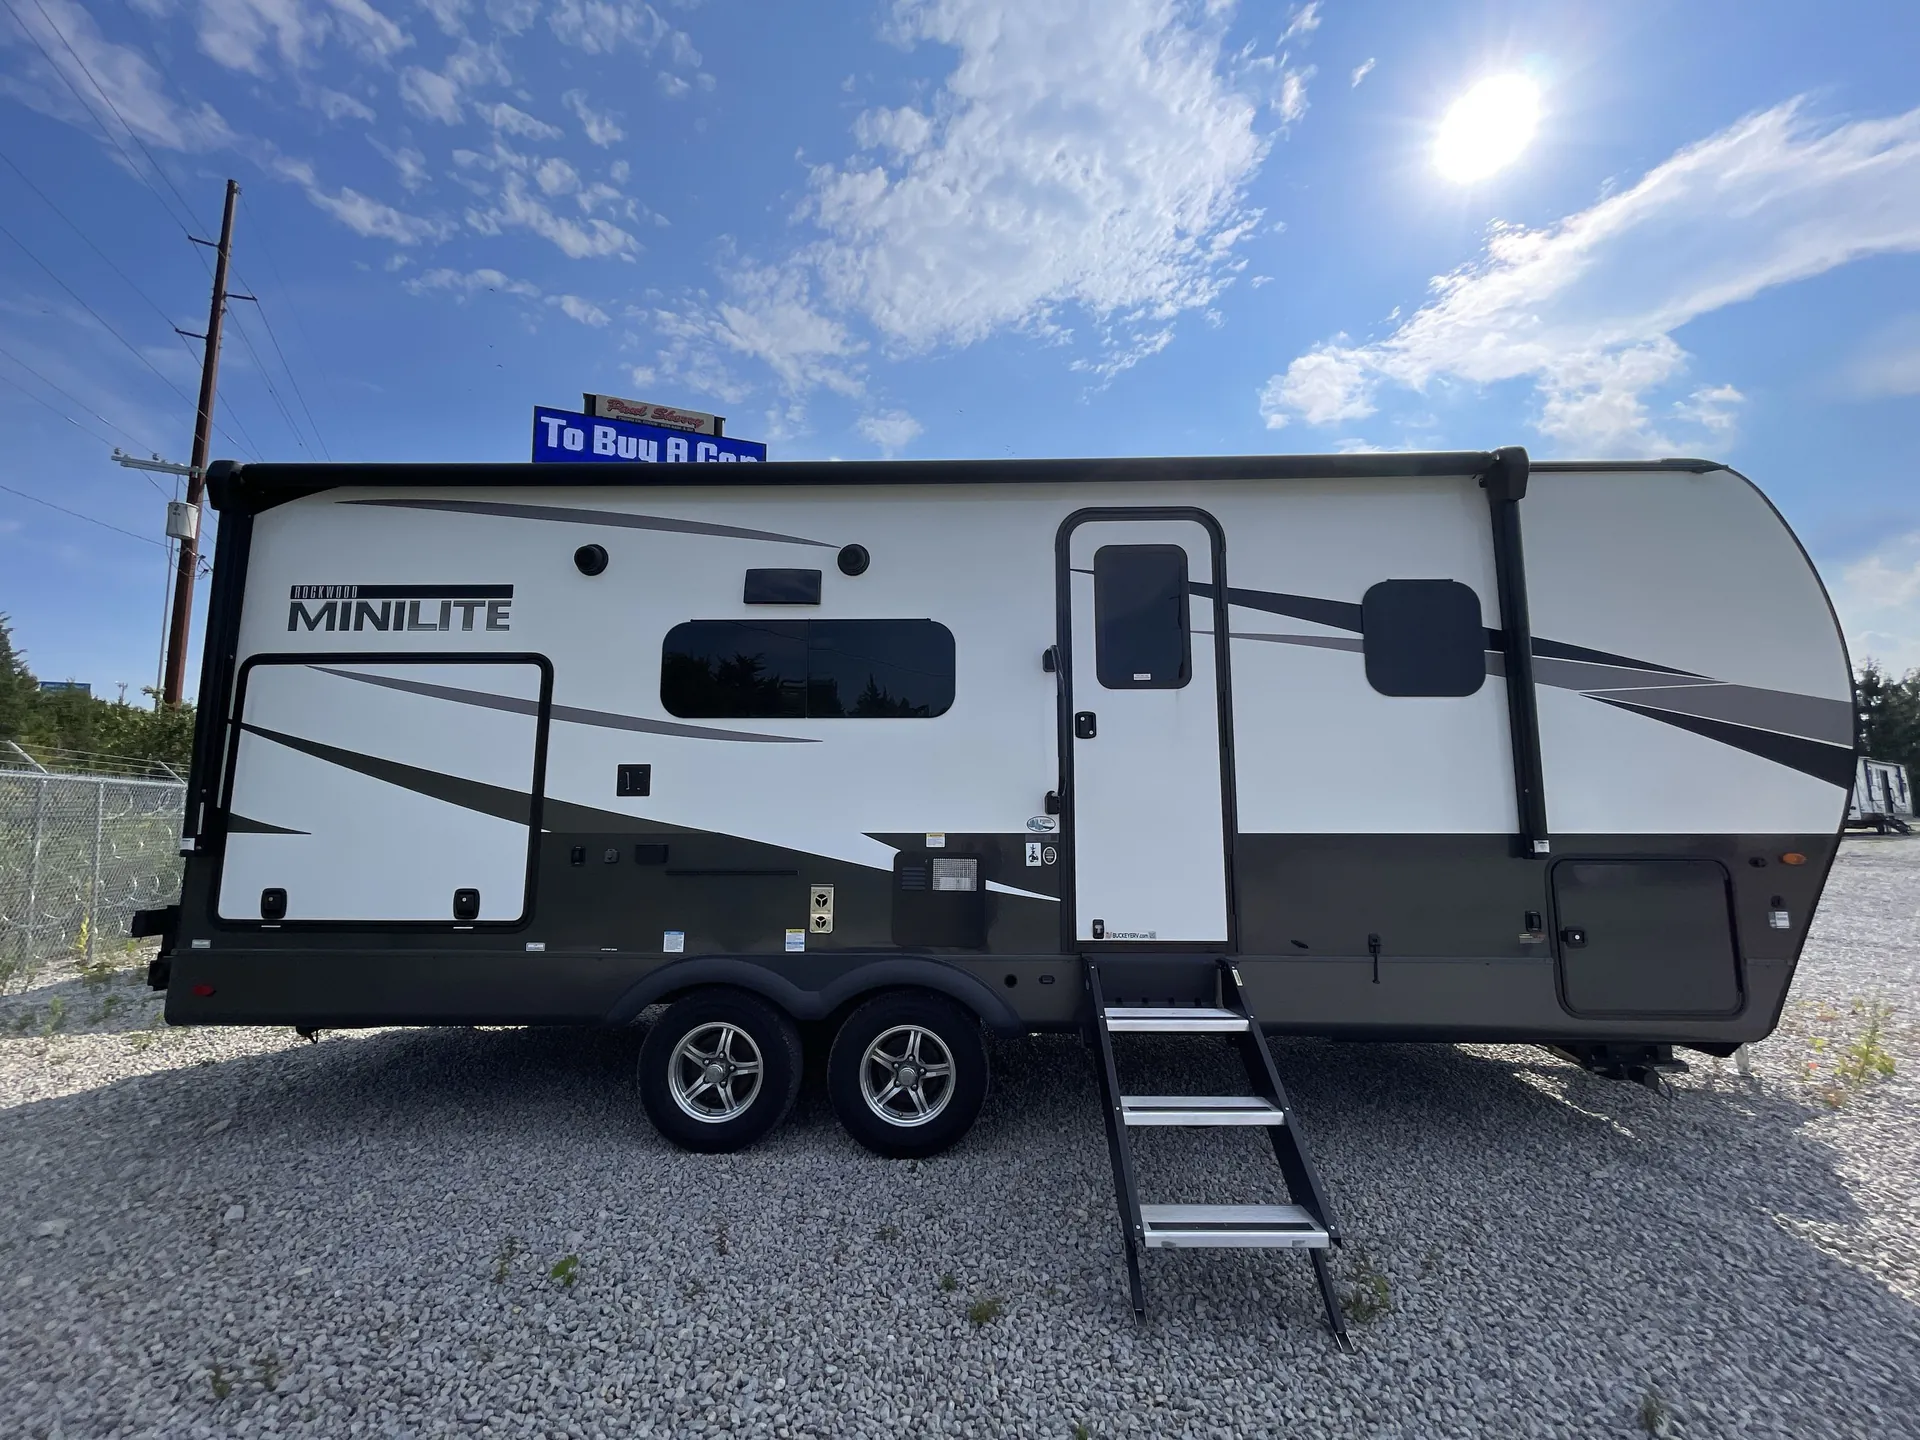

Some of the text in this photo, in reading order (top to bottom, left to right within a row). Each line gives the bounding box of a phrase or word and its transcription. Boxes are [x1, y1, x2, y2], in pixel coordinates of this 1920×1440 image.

[541, 416, 584, 451] To
[593, 424, 658, 463] Buy
[667, 436, 688, 463] A
[294, 585, 358, 599] ROCKWOOD
[287, 600, 512, 632] MINILITE
